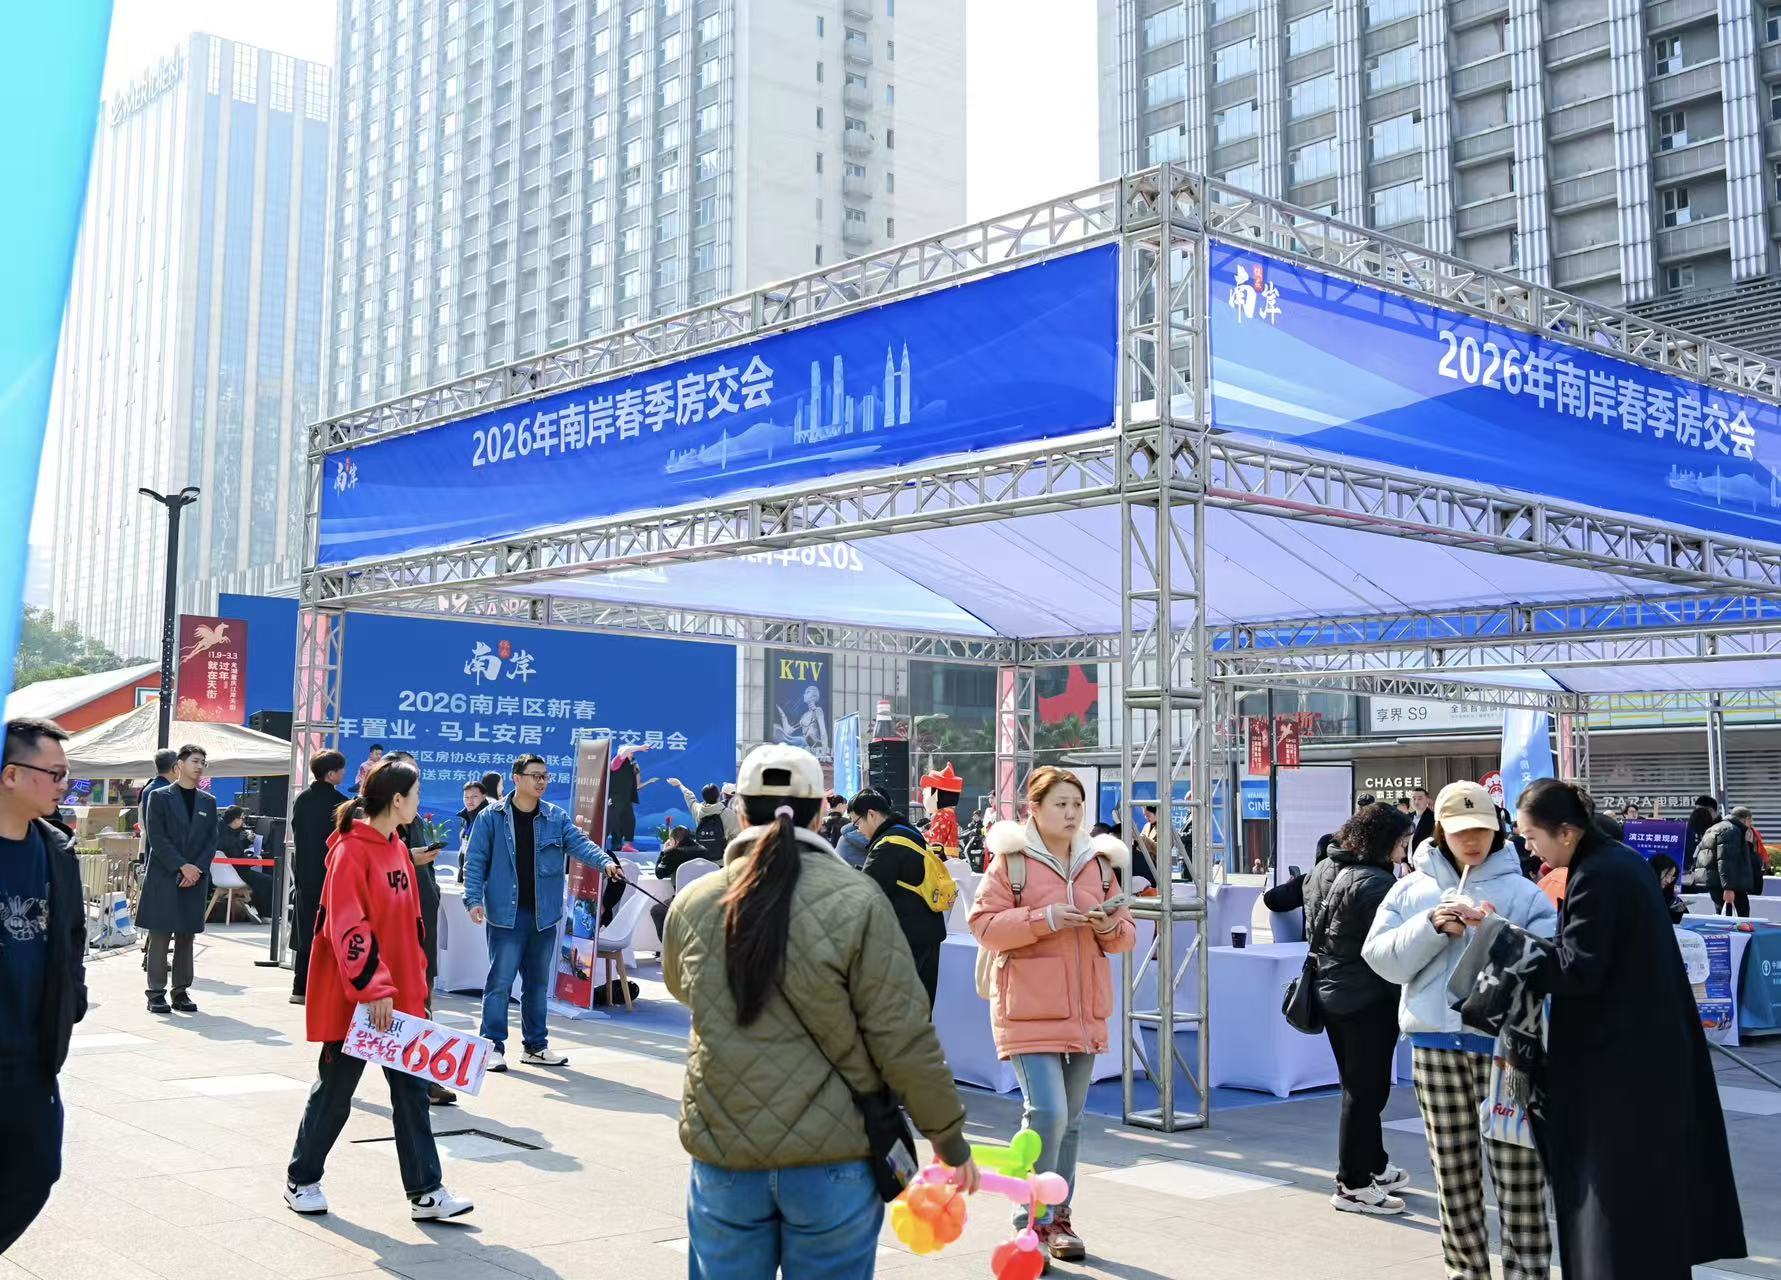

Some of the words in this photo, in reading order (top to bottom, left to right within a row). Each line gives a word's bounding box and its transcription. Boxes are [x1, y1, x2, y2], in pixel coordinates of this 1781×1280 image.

[1229, 264, 1282, 325] 南岸
[1438, 330, 1756, 461] 2026年南岸春季房交会
[472, 354, 774, 467] 2026年南岸春季房交会
[218, 661, 229, 681] 过年
[463, 640, 537, 686] 南岸
[779, 658, 823, 682] KTV
[206, 660, 218, 700] 就在天街
[398, 690, 597, 721] 2026南岸区新春
[1376, 707, 1402, 723] 享界
[1408, 706, 1428, 721] S9
[1365, 777, 1422, 788] CHAGEE
[1463, 797, 1475, 809] LA
[1628, 832, 1679, 843] 滨江实景现房
[386, 869, 409, 896] UFO
[347, 933, 366, 961] UFO
[401, 1029, 477, 1087] 199
